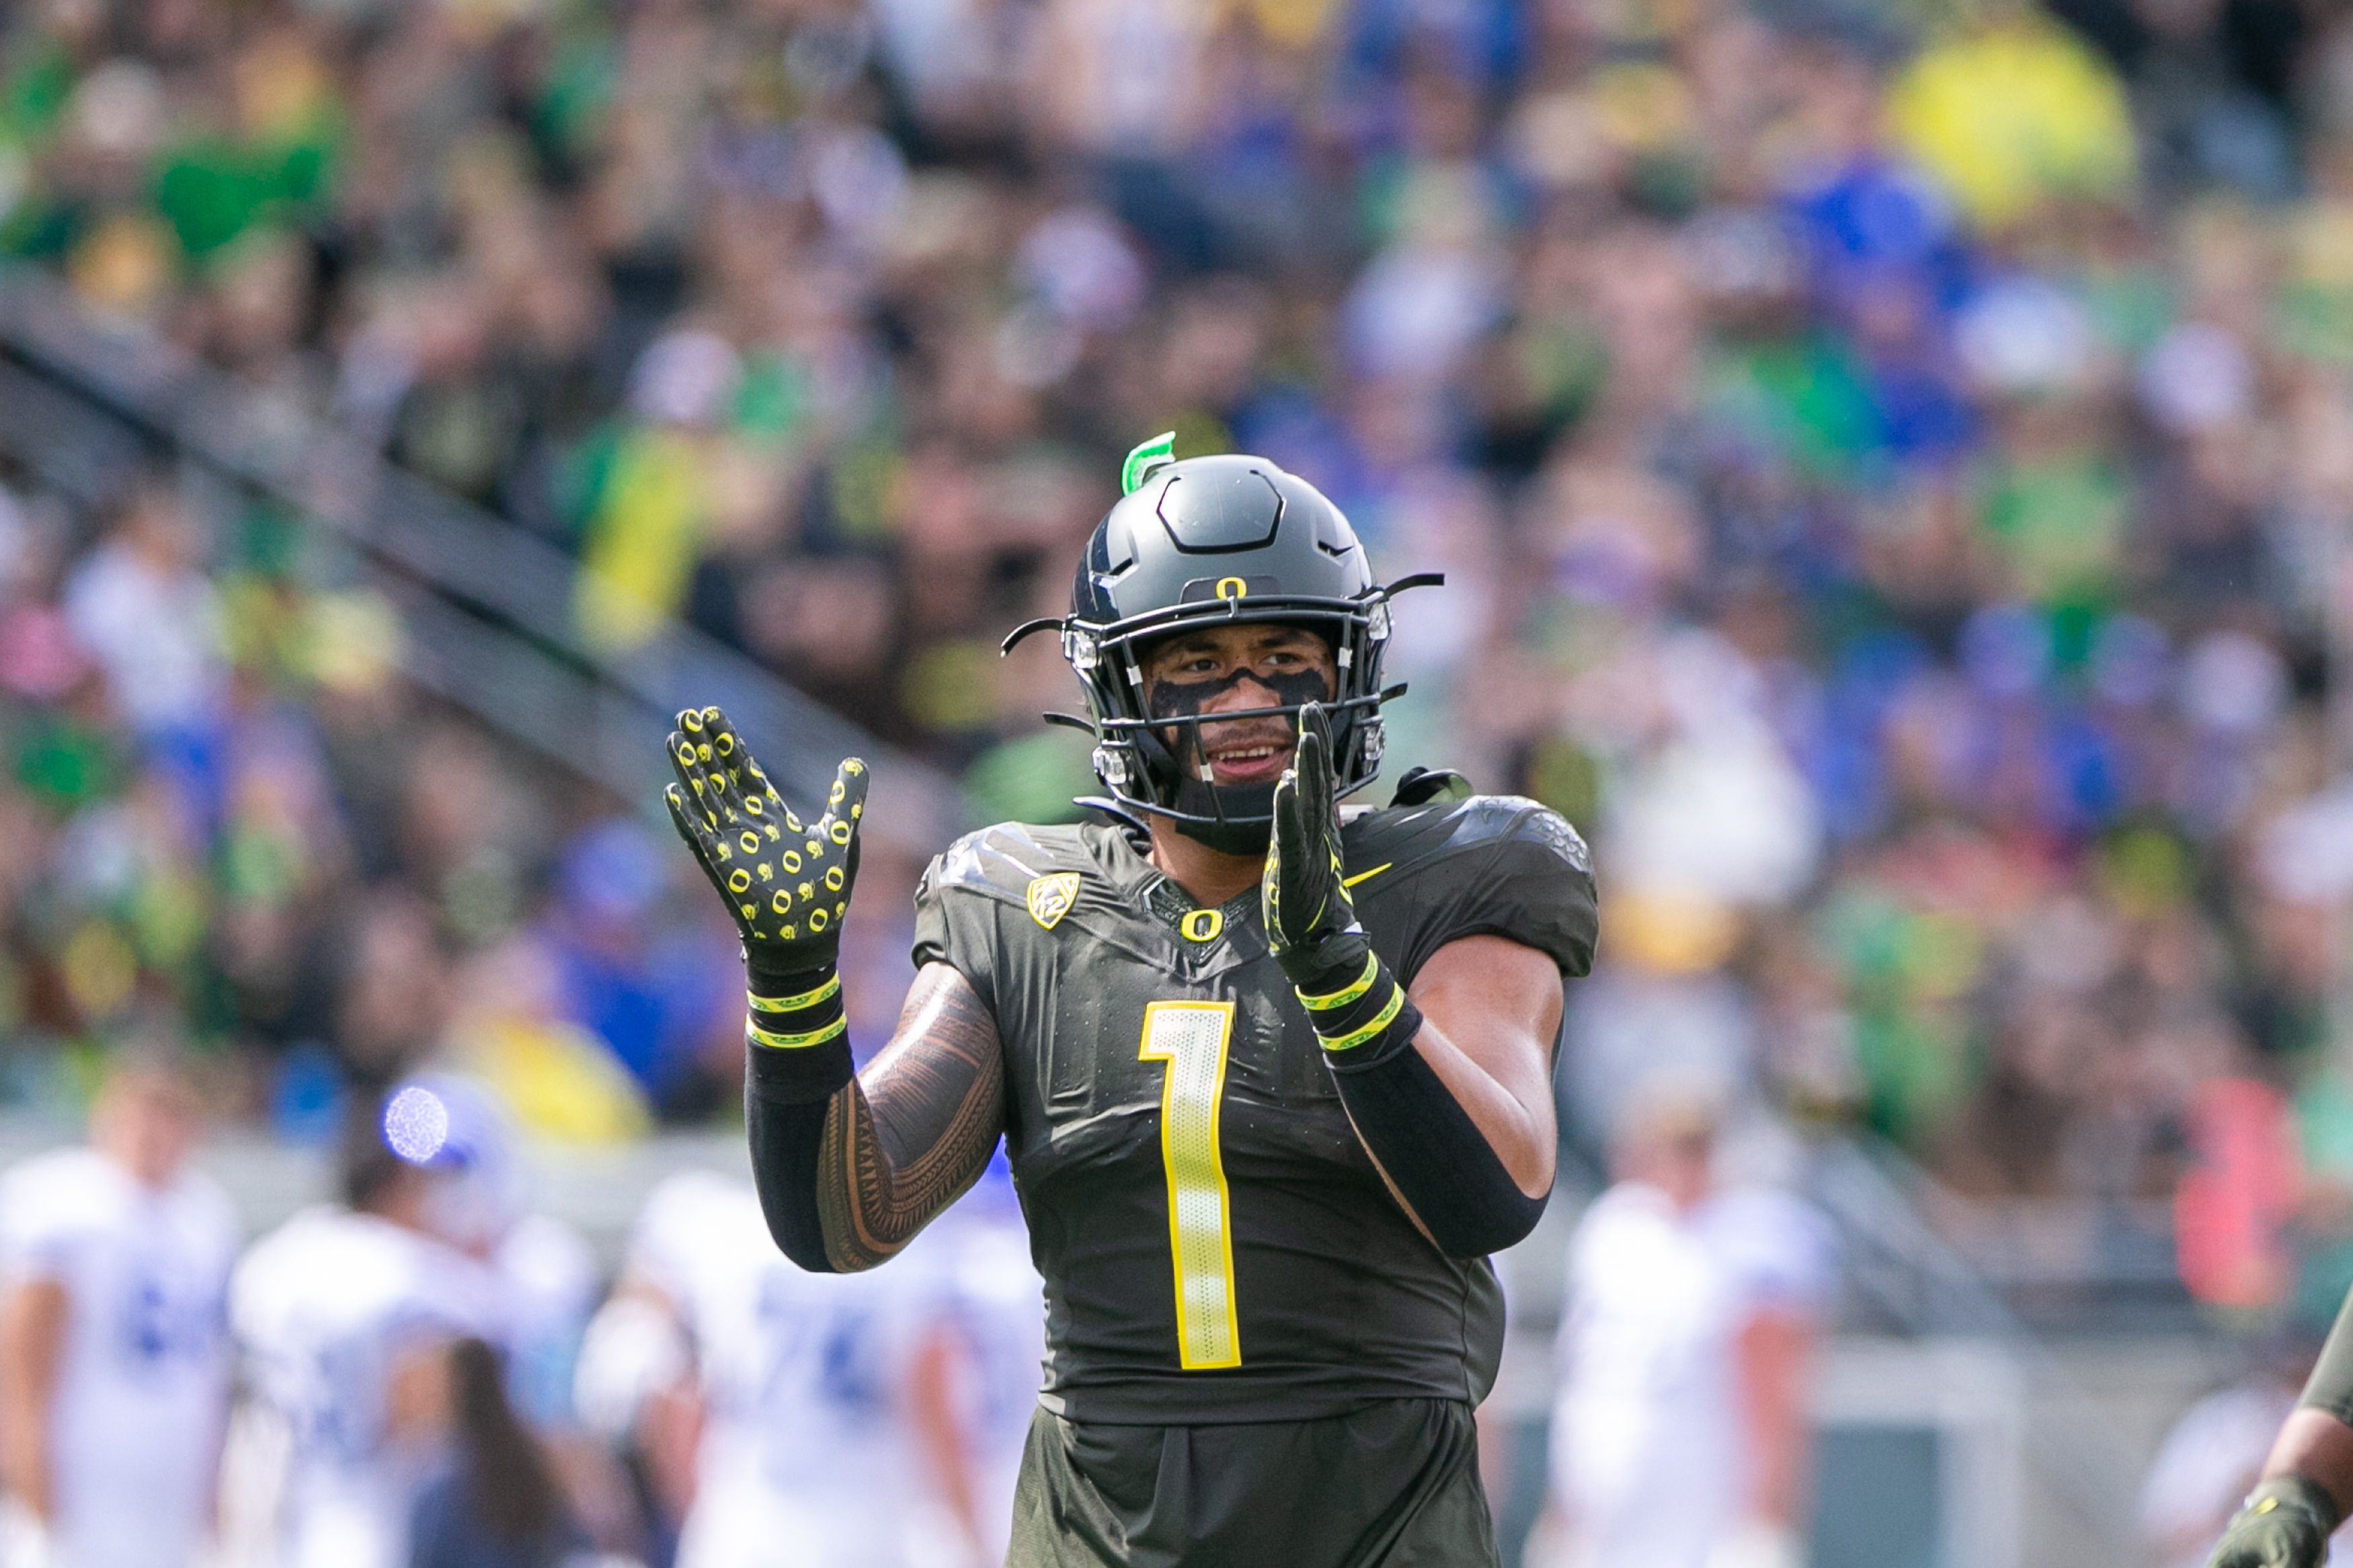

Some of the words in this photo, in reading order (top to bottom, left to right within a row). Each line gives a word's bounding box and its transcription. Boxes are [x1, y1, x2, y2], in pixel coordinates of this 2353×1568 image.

[1216, 577, 1246, 600] O
[685, 709, 703, 733] O
[678, 741, 696, 766] O
[715, 732, 734, 756] O
[745, 795, 762, 815] O
[740, 831, 759, 854] O
[830, 820, 849, 845] O
[783, 850, 801, 873] O
[729, 868, 750, 893] O
[825, 866, 844, 891] O
[772, 889, 791, 914] O
[1036, 895, 1066, 919] 12
[809, 907, 828, 932] O
[1181, 909, 1223, 942] O
[1138, 1000, 1242, 1370] 1
